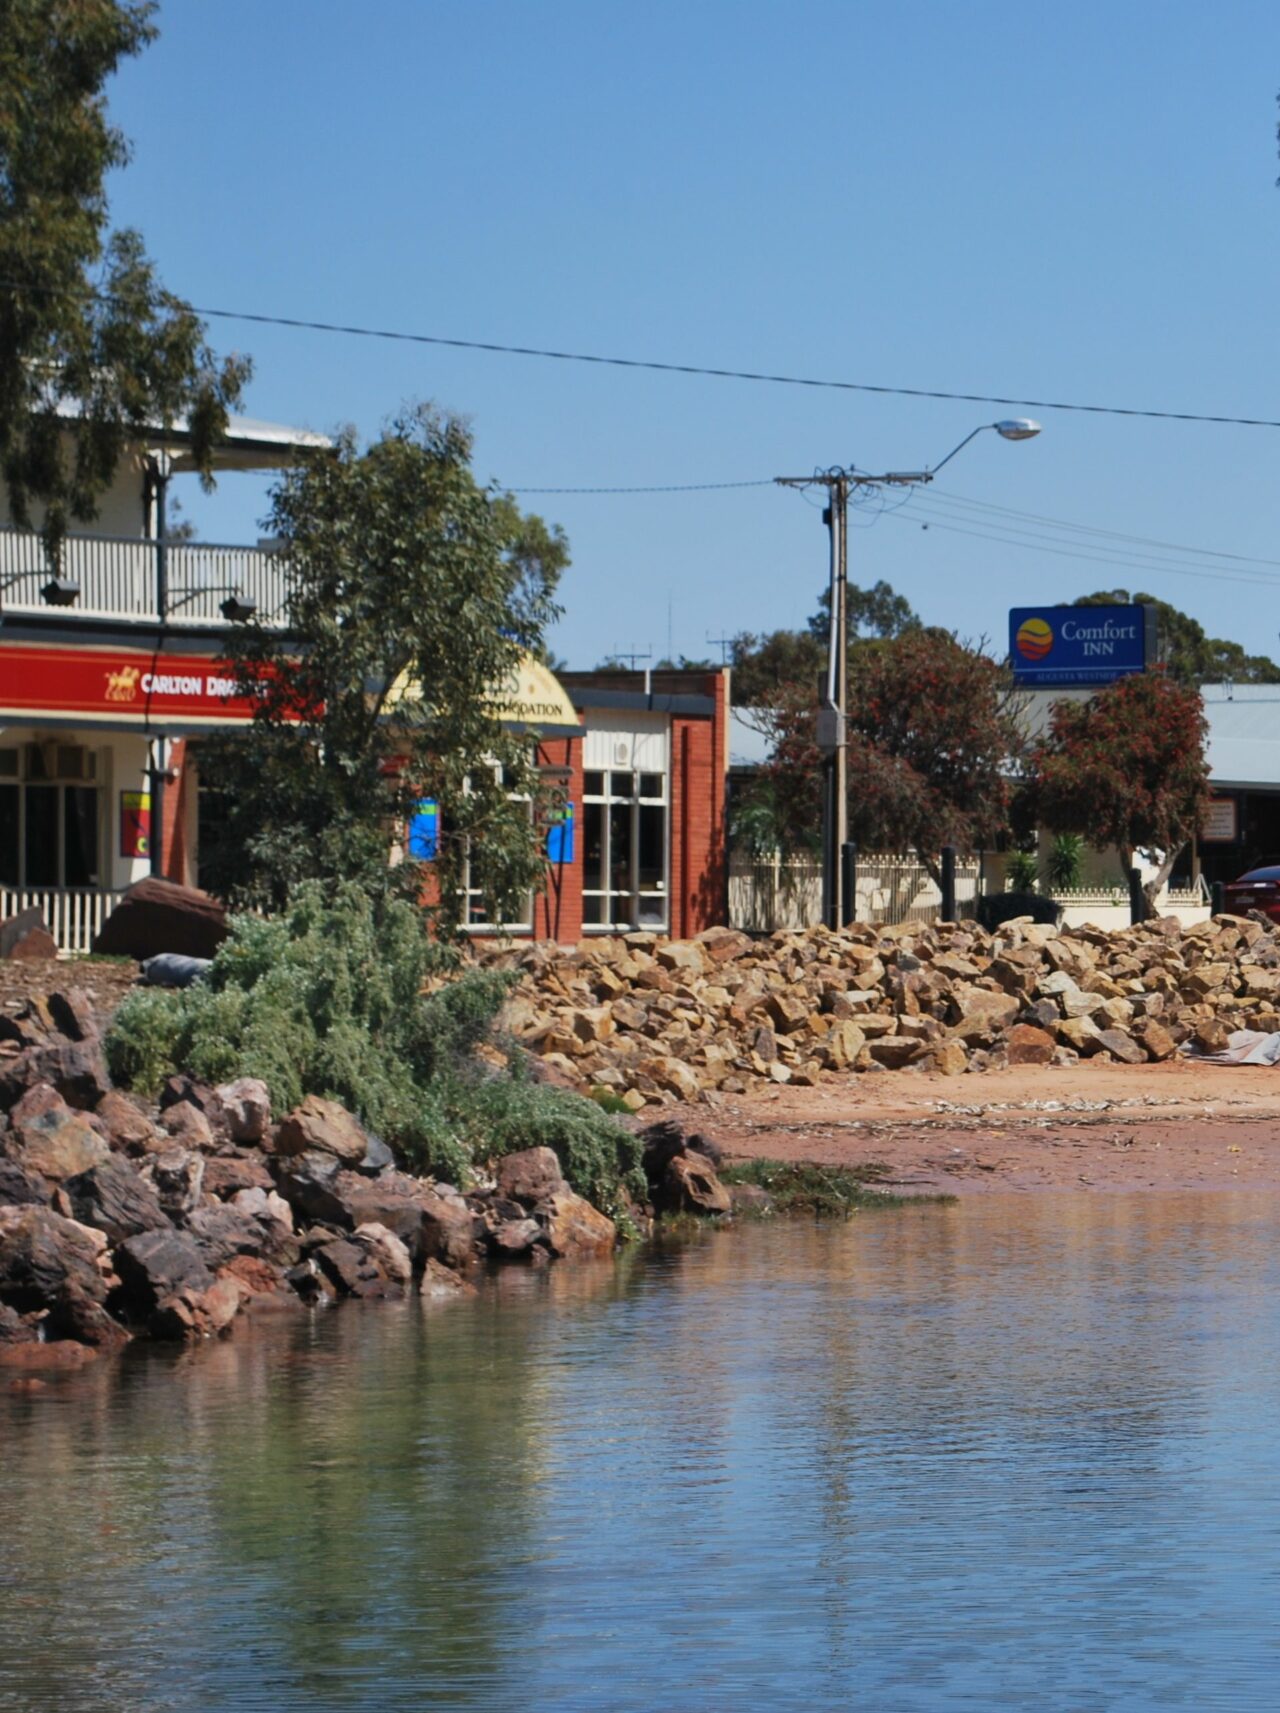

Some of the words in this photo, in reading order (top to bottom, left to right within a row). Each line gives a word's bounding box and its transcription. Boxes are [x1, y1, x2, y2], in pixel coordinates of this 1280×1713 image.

[1061, 620, 1136, 640] Comfort
[1083, 642, 1114, 656] INN
[140, 673, 202, 695] CARLTON
